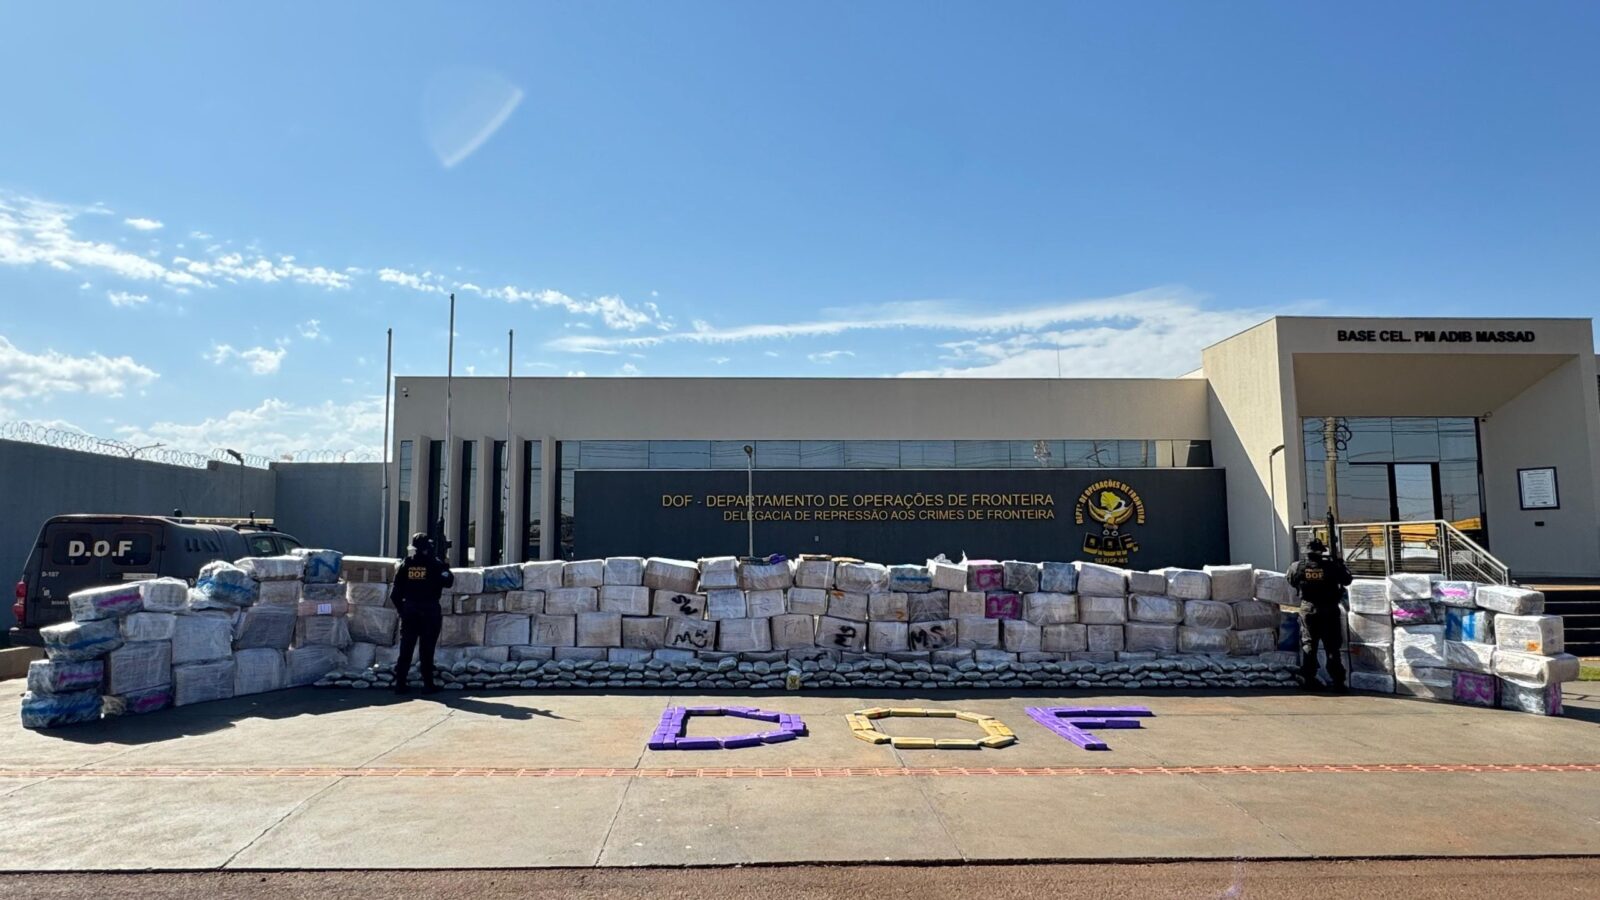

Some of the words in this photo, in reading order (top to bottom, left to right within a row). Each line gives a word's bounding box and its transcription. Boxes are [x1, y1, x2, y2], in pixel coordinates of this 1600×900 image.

[1337, 330, 1376, 342] BASE
[1379, 330, 1411, 342] CEL.
[1415, 331, 1435, 342] PM
[1439, 331, 1472, 342] ADIB
[1476, 331, 1535, 342] MASSAD
[1085, 479, 1121, 497] OPERAÇÕES
[662, 495, 693, 507] DOF
[706, 494, 825, 507] DEPARTAMENTO
[829, 494, 848, 507] DE
[853, 492, 944, 509] OPERAÇÕES
[948, 494, 968, 507] DE
[972, 494, 1054, 507] FRONTEIRA
[723, 510, 792, 521] DELEGACIA
[794, 510, 811, 521] DE
[814, 508, 888, 520] REPRESSÃO
[890, 510, 916, 520] AOS
[918, 510, 965, 520] CRIMES
[967, 509, 984, 520] DE
[987, 509, 1055, 520] FRONTEIRA
[68, 540, 133, 556] D.O.F
